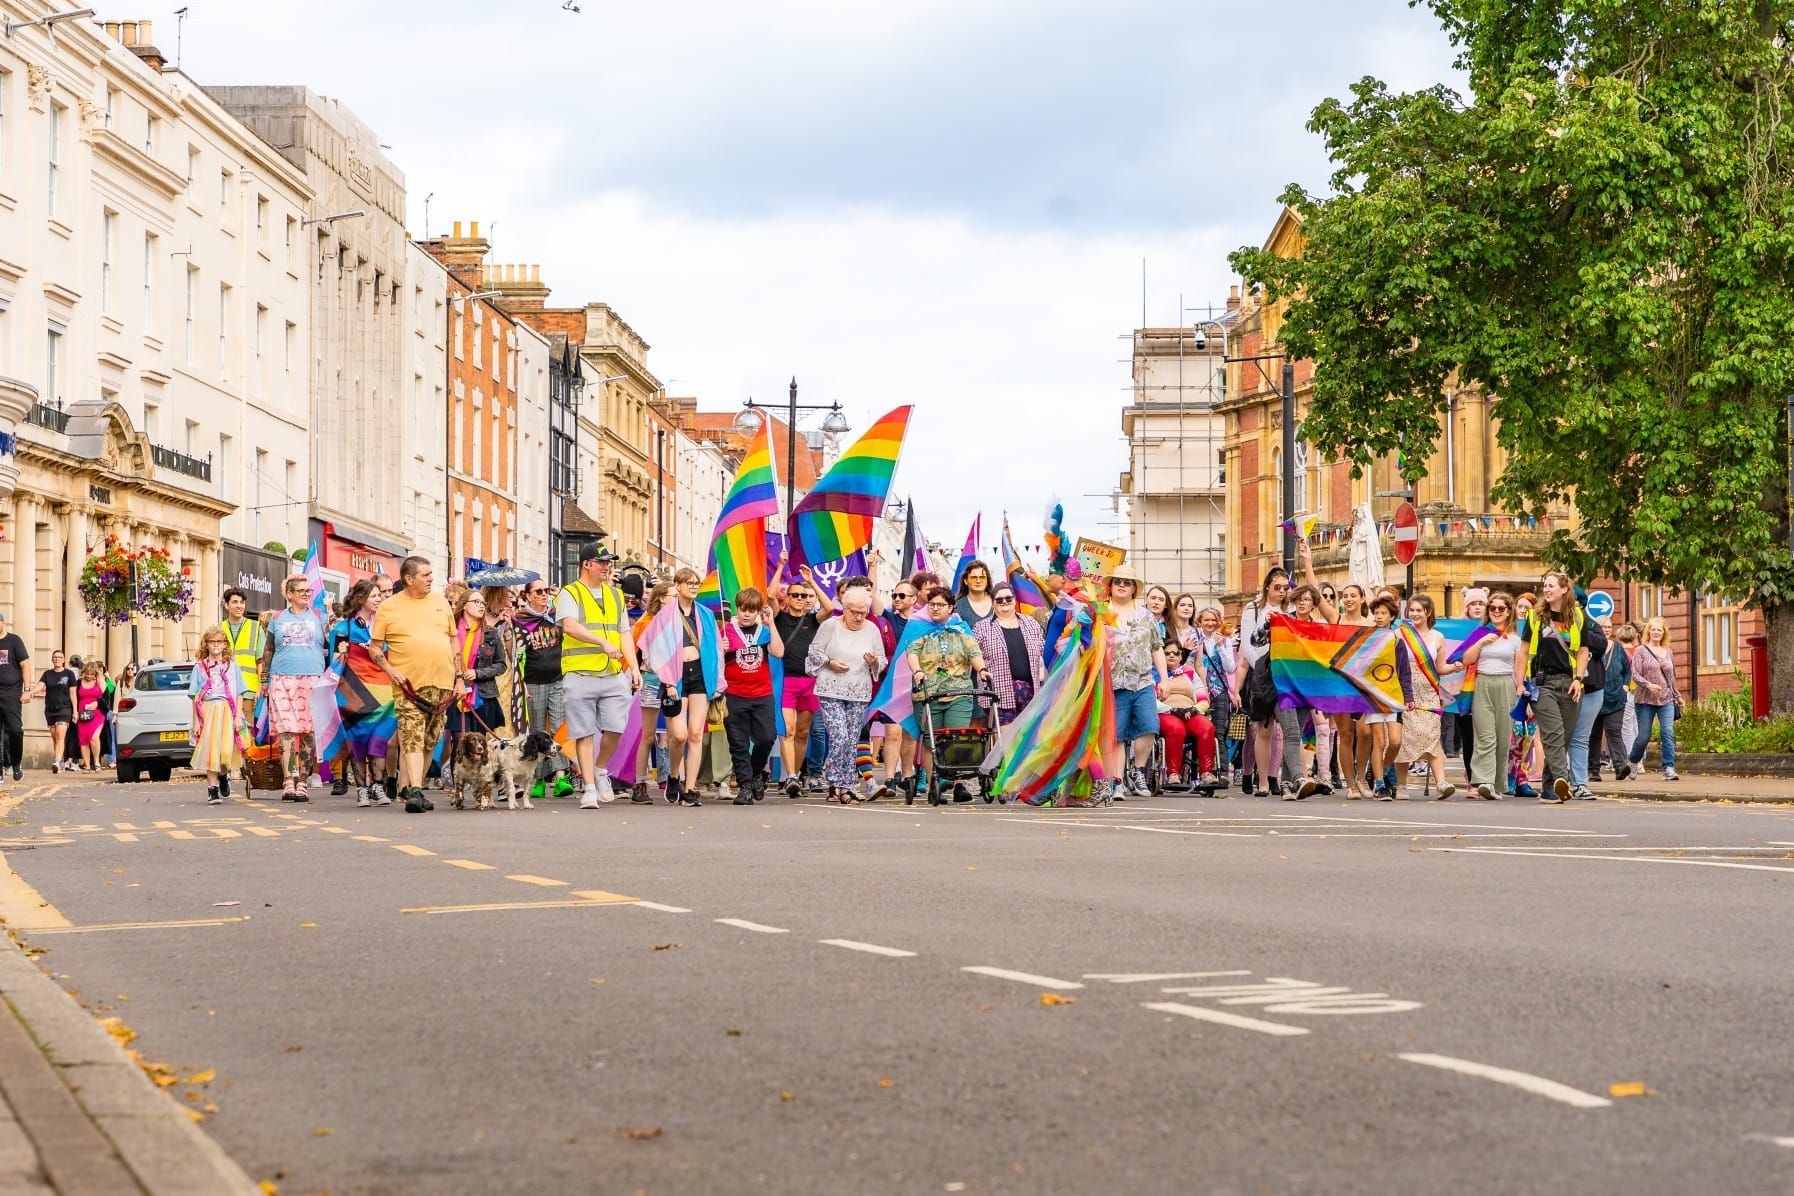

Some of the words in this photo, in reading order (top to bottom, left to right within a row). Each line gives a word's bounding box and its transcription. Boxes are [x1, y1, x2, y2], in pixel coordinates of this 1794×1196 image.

[469, 561, 480, 570] All
[238, 570, 250, 590] Cats
[249, 573, 272, 595] Protection
[41, 817, 255, 834] BUS
[0, 825, 308, 845] STOP
